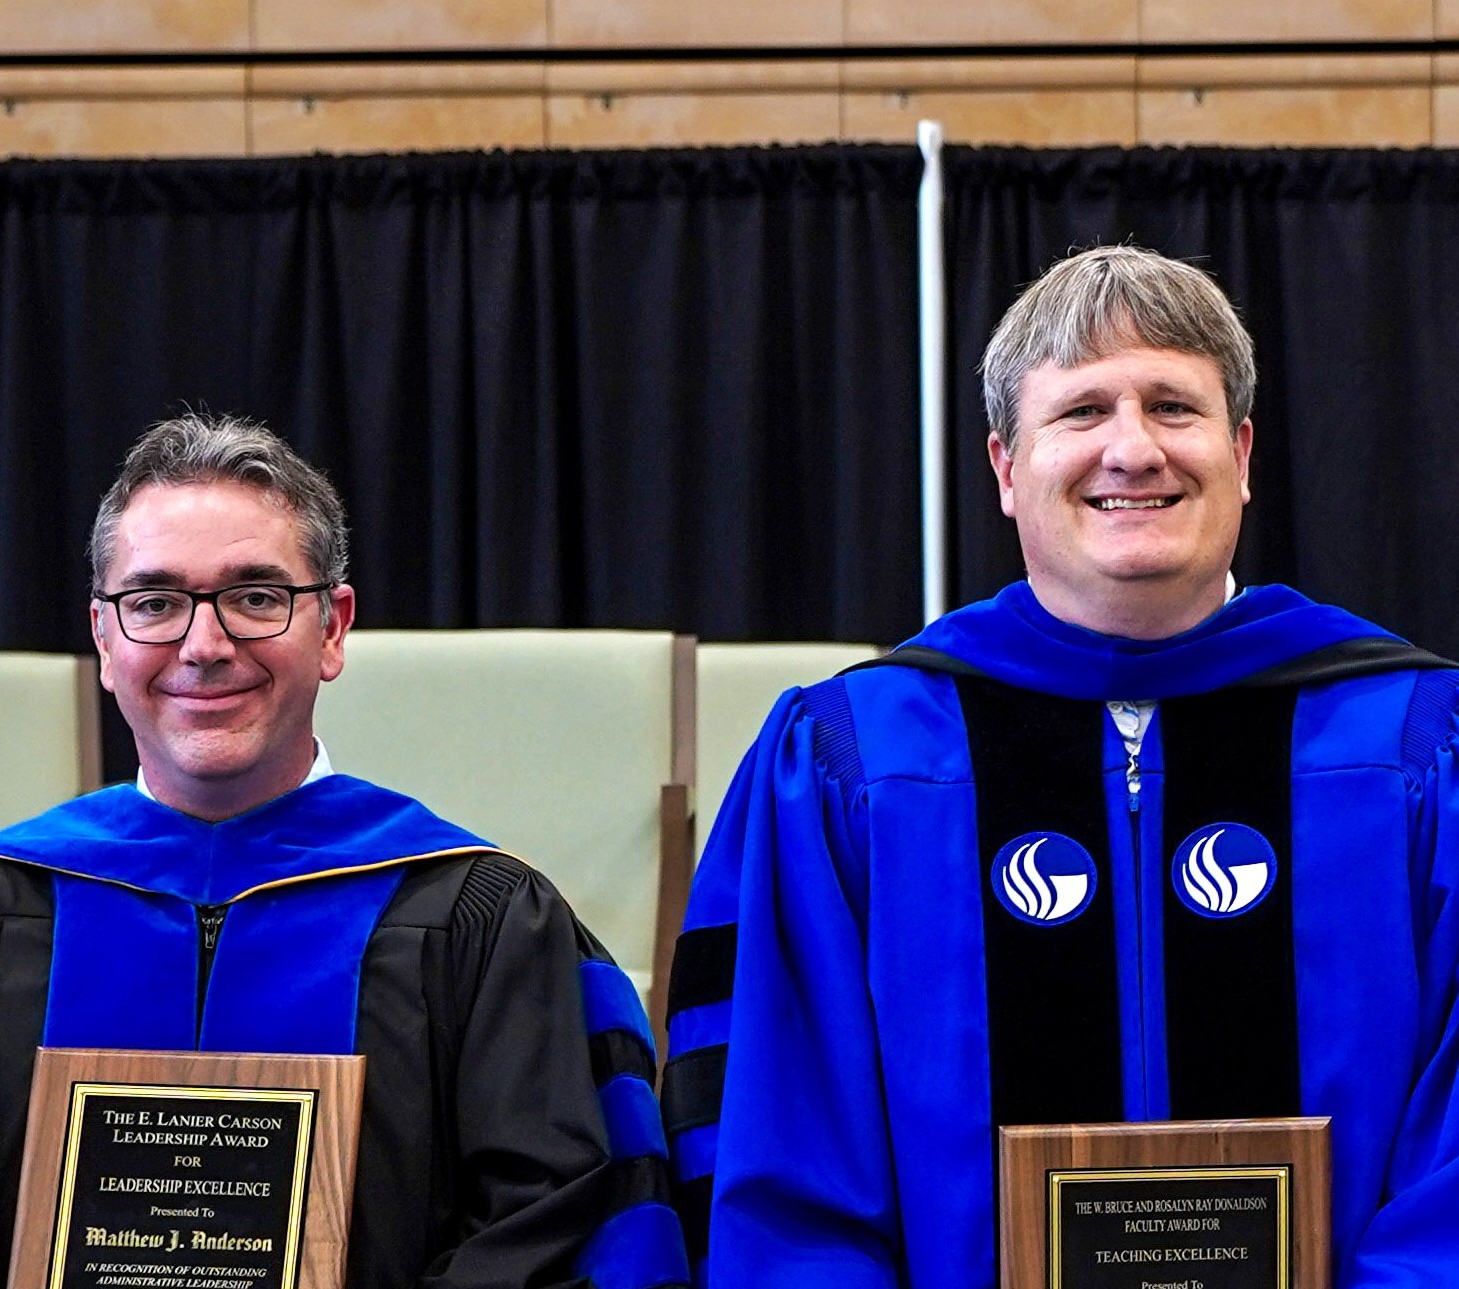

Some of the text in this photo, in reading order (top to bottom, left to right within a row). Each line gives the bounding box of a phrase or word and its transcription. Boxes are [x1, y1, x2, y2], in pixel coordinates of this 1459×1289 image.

[102, 1109, 282, 1130] THE E. LANIER CARSON
[112, 1128, 269, 1148] LEADERSHIP AWARD
[173, 1155, 202, 1167] FOR
[98, 1176, 271, 1197] LEADERSHIP EXCELLENCE
[149, 1205, 215, 1218] Presented To
[1074, 1201, 1092, 1215] THE
[1104, 1199, 1134, 1214] BRUCE
[1133, 1199, 1154, 1213] AND
[1154, 1198, 1194, 1212] ROSALYN
[1195, 1197, 1213, 1211] RAY
[1214, 1196, 1267, 1211] DONALDSON
[1124, 1217, 1220, 1233] FACULTY AWARD FOR
[85, 1226, 272, 1252] Matthew J. Anderson
[1094, 1246, 1248, 1263] TEACHING EXCELLENCE
[84, 1262, 267, 1278] IN RECOGNITION OF OUTSTANDING
[95, 1275, 253, 1289] ADMINISTRATIVE LEADERSHIP
[1190, 1279, 1204, 1289] To
